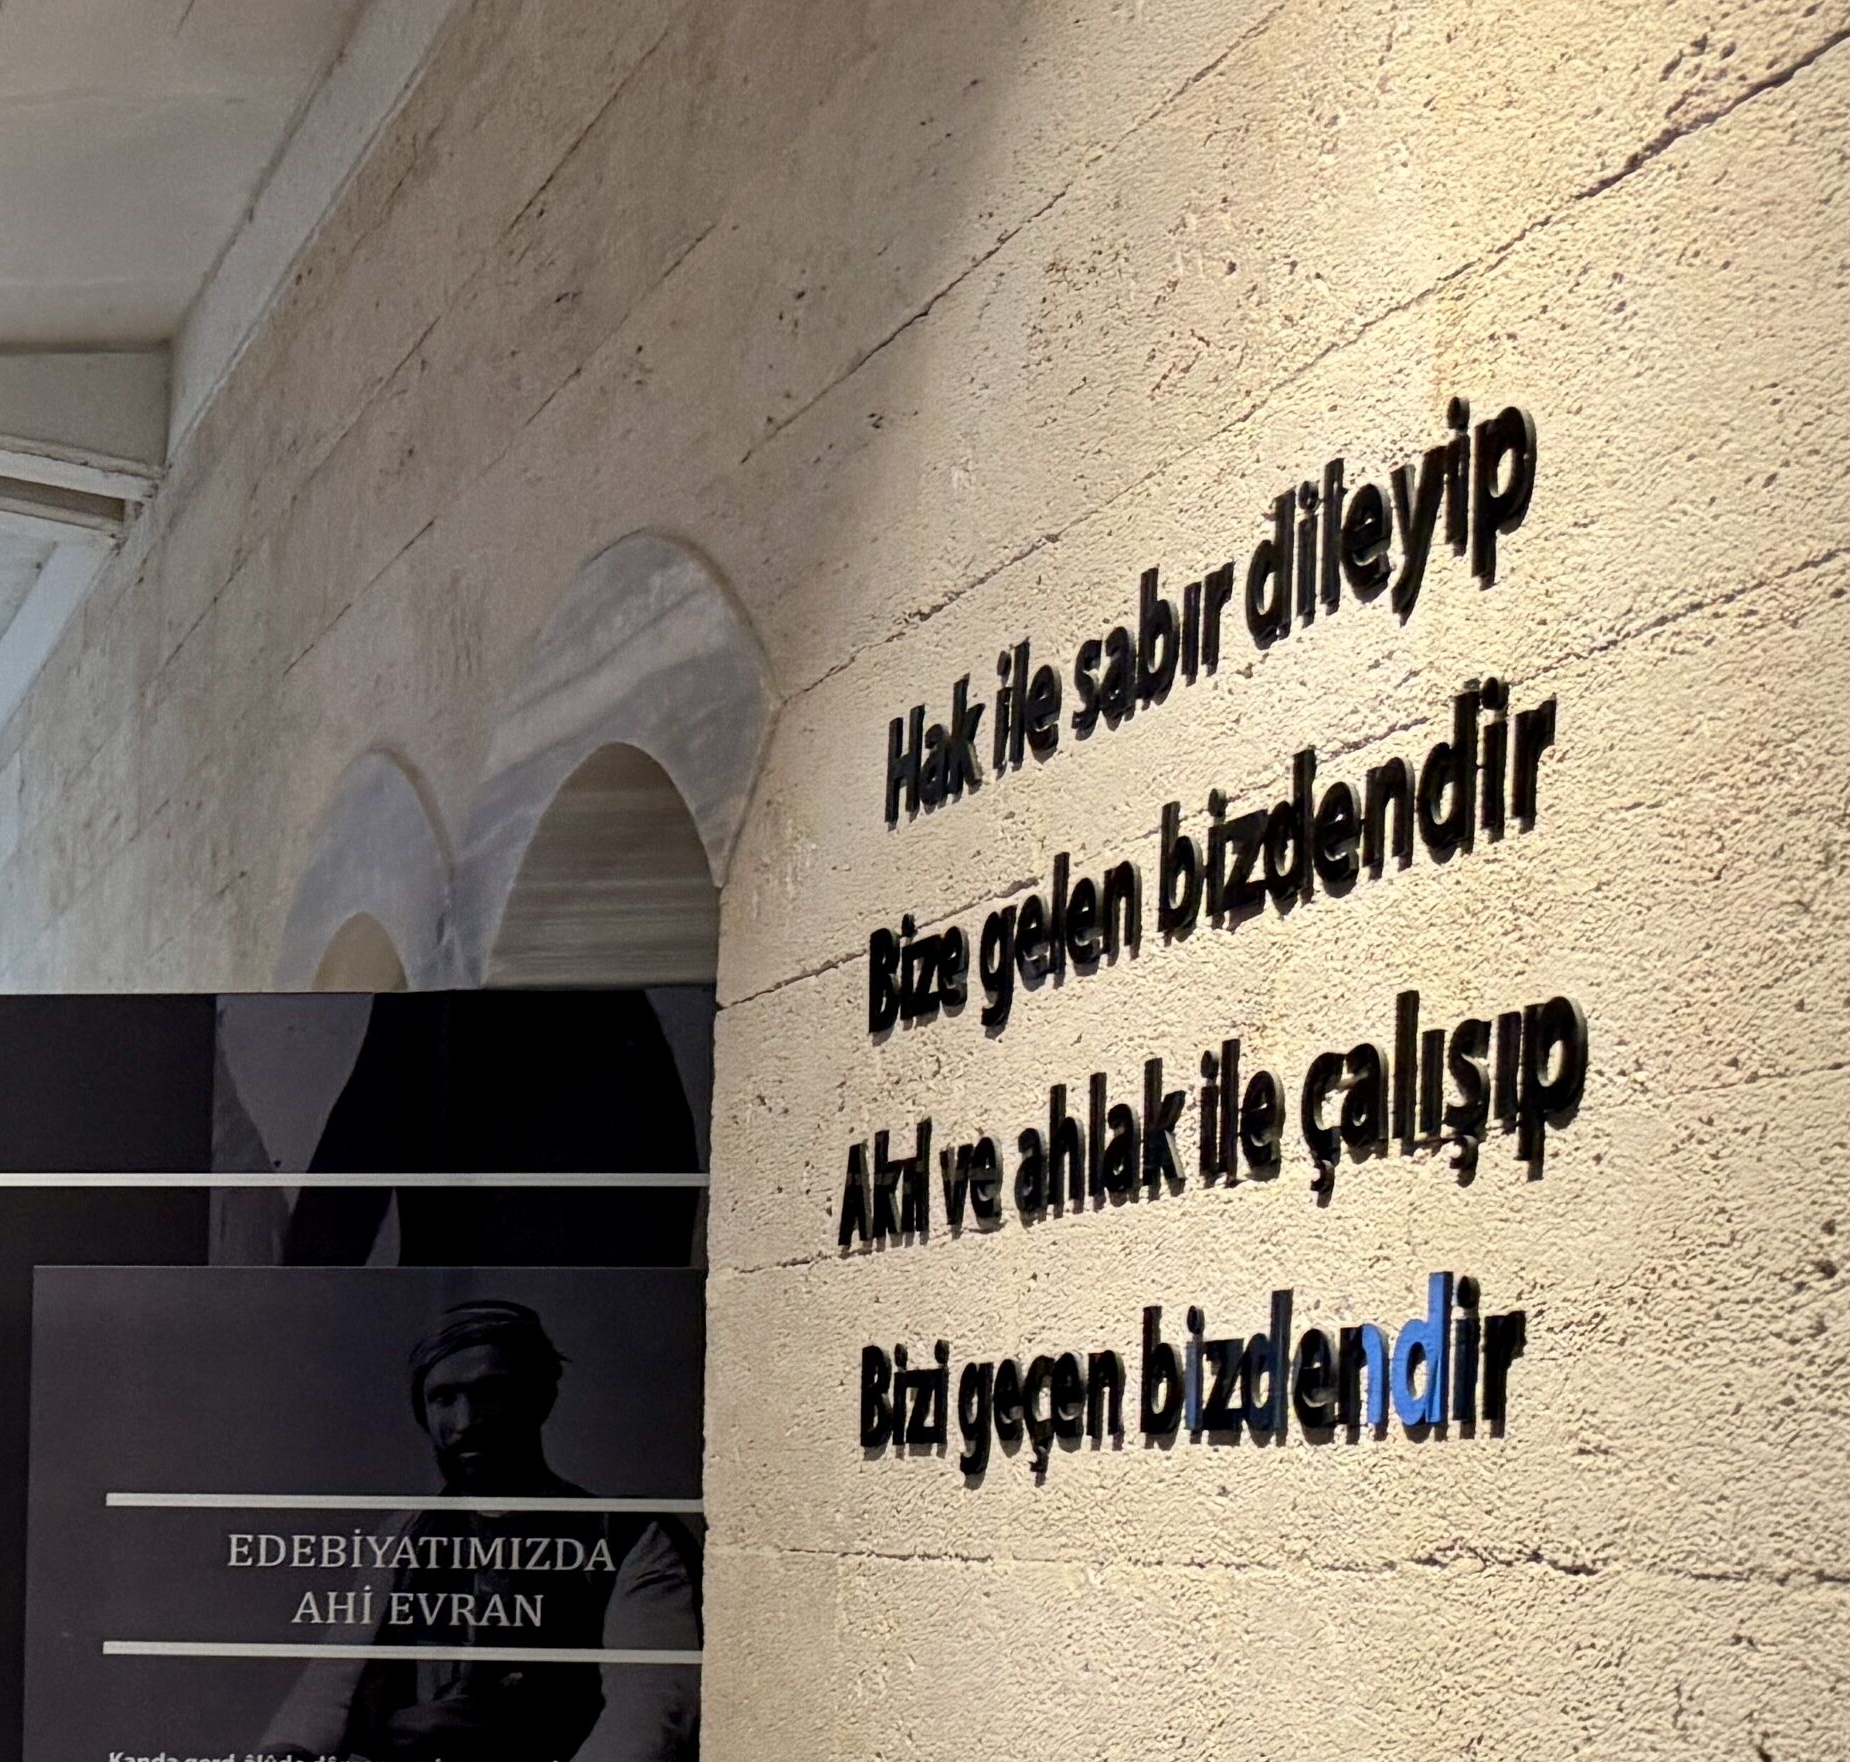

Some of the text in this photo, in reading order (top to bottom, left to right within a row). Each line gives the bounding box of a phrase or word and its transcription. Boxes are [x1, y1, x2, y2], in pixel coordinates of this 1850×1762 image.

[885, 396, 1538, 830] Hak ile sabır dileyip
[869, 677, 1557, 1032] Bize gelen bizdendir
[838, 990, 1589, 1248] Akıl ve ahlak ile çalışıp
[860, 1270, 1527, 1480] Bizi geçen bizdendir
[227, 1528, 617, 1572] EDEBİYATIMIZDA
[291, 1584, 545, 1628] AHİ EVRAN
